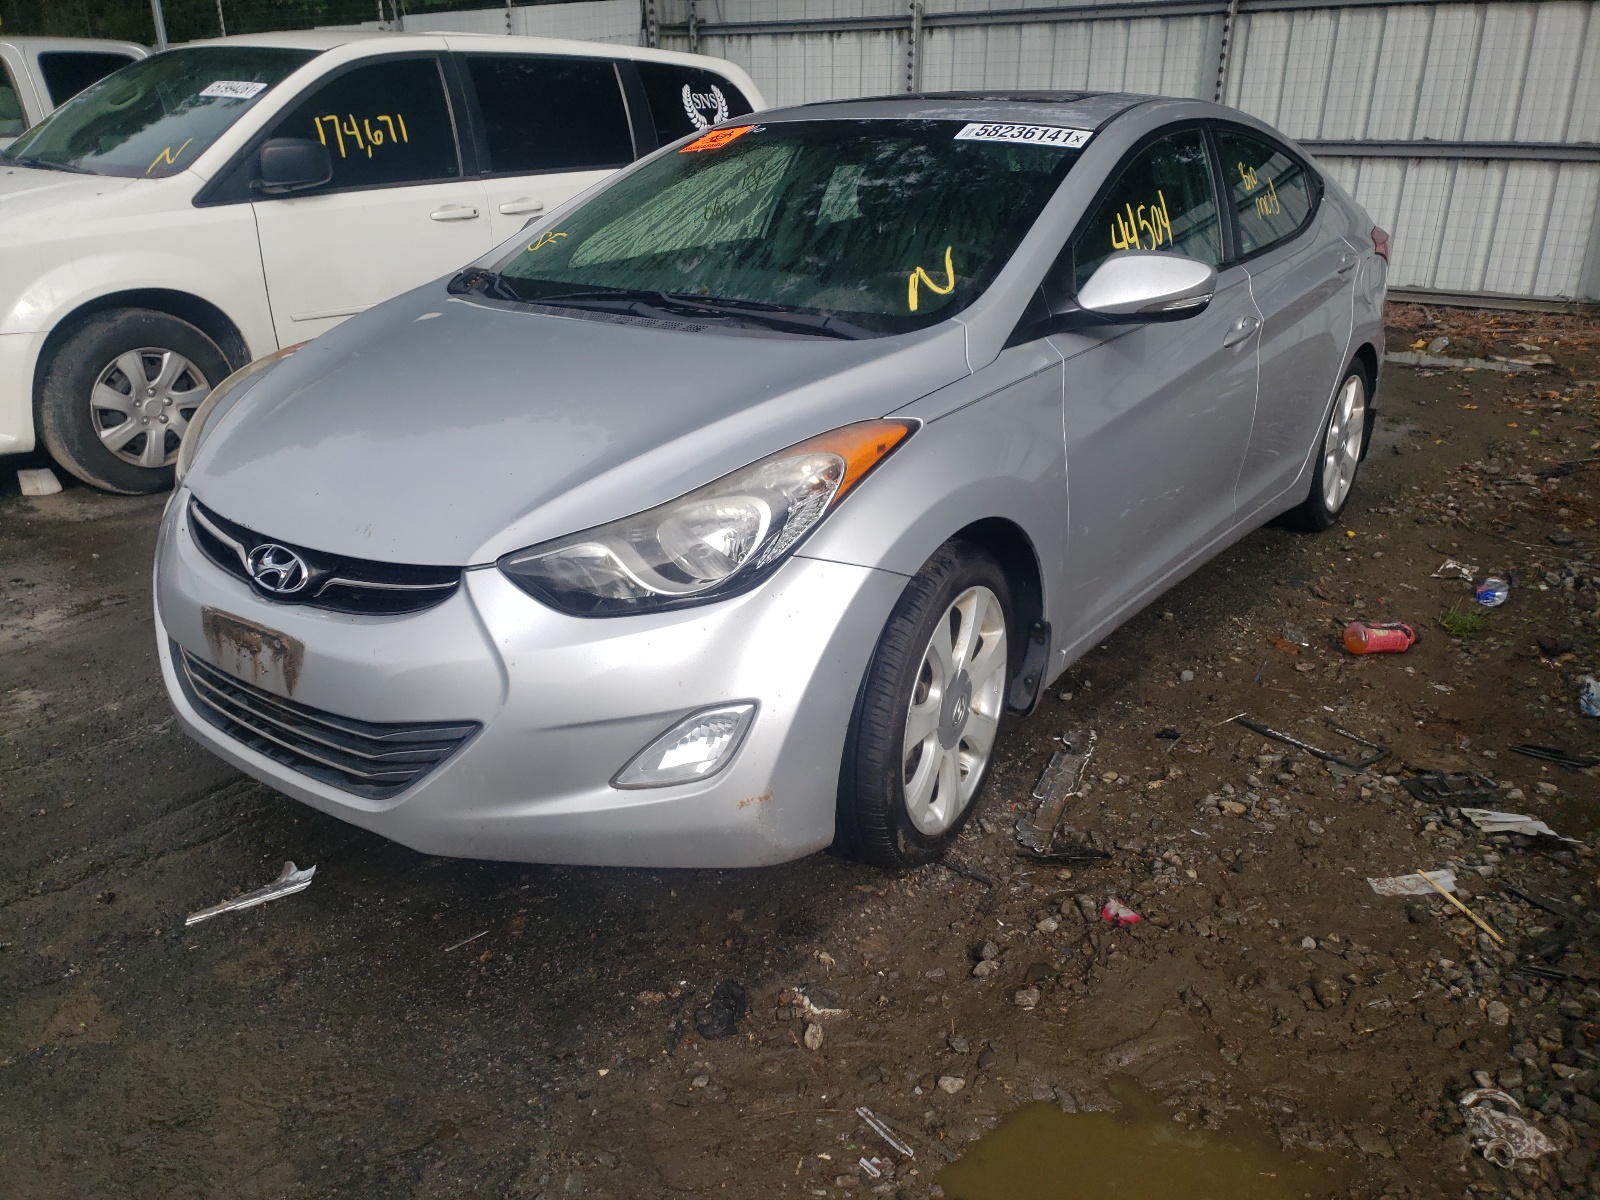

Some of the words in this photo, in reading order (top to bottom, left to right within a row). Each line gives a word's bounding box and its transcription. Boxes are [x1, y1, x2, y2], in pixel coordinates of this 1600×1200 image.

[691, 93, 718, 109] SNS
[314, 113, 408, 158] 174,671
[975, 124, 1074, 143] 58236141
[1111, 189, 1173, 251] 44504
